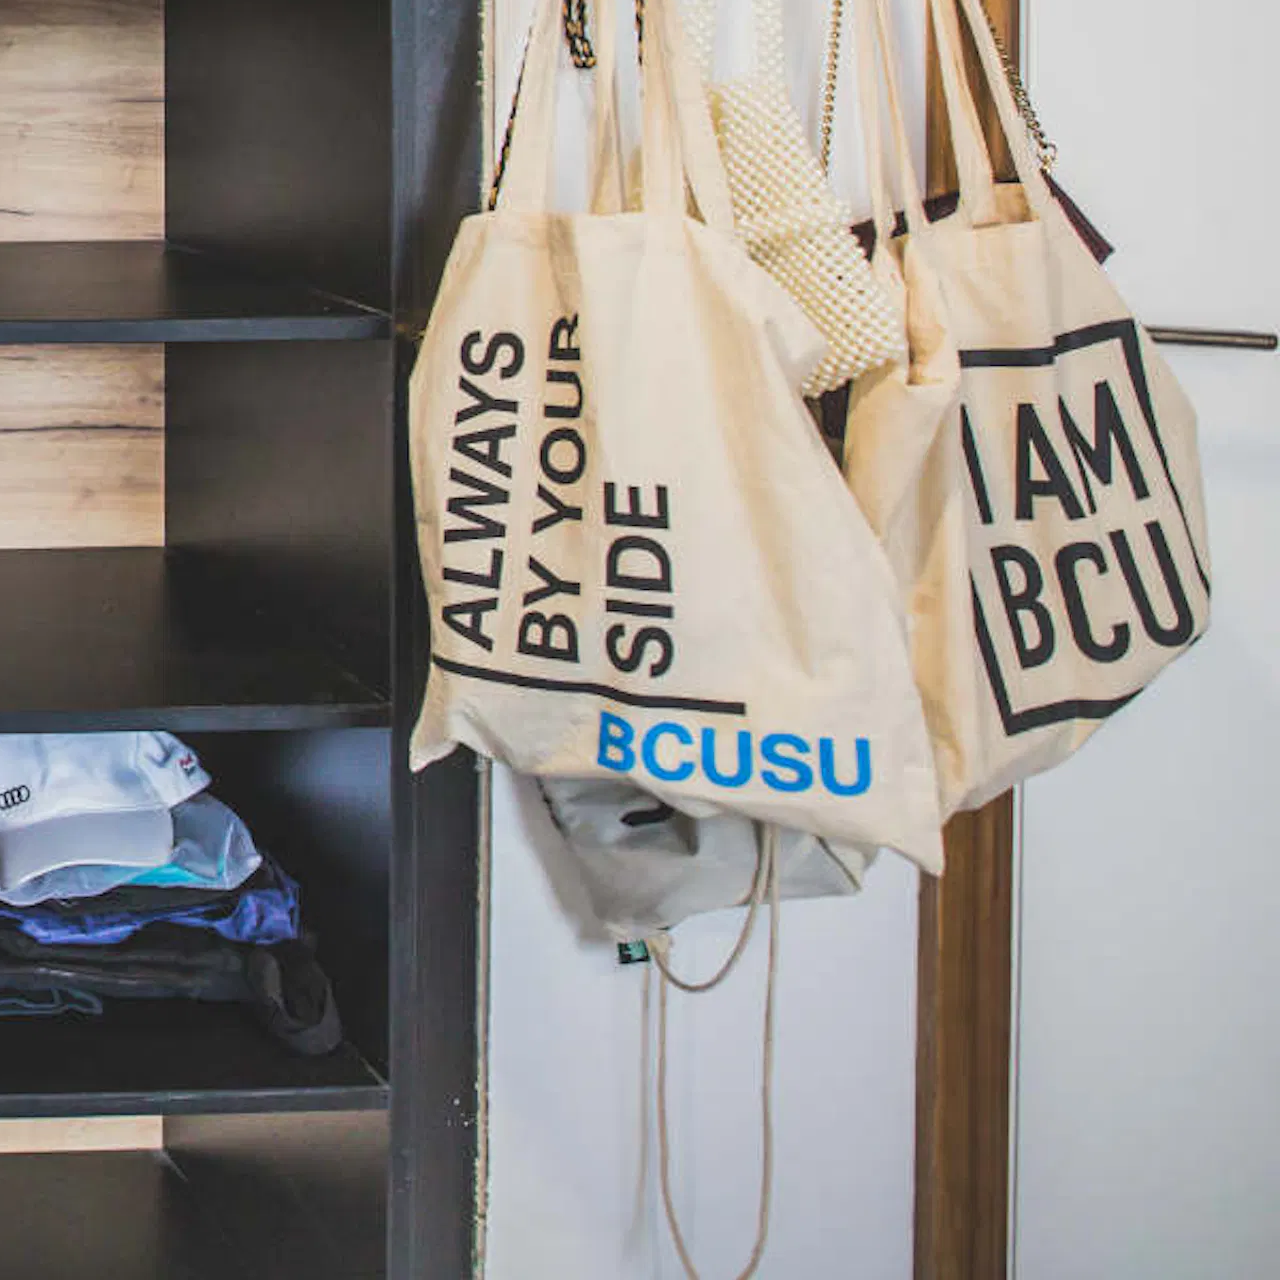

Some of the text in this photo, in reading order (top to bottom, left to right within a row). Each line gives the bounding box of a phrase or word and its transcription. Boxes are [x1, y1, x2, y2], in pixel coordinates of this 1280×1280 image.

[441, 330, 525, 652] ALWAYS
[516, 313, 586, 664] BY YOUR
[960, 380, 1150, 525] I AM
[603, 481, 675, 678] SIDE
[990, 520, 1194, 670] BCU
[597, 710, 873, 796] BCUSU
